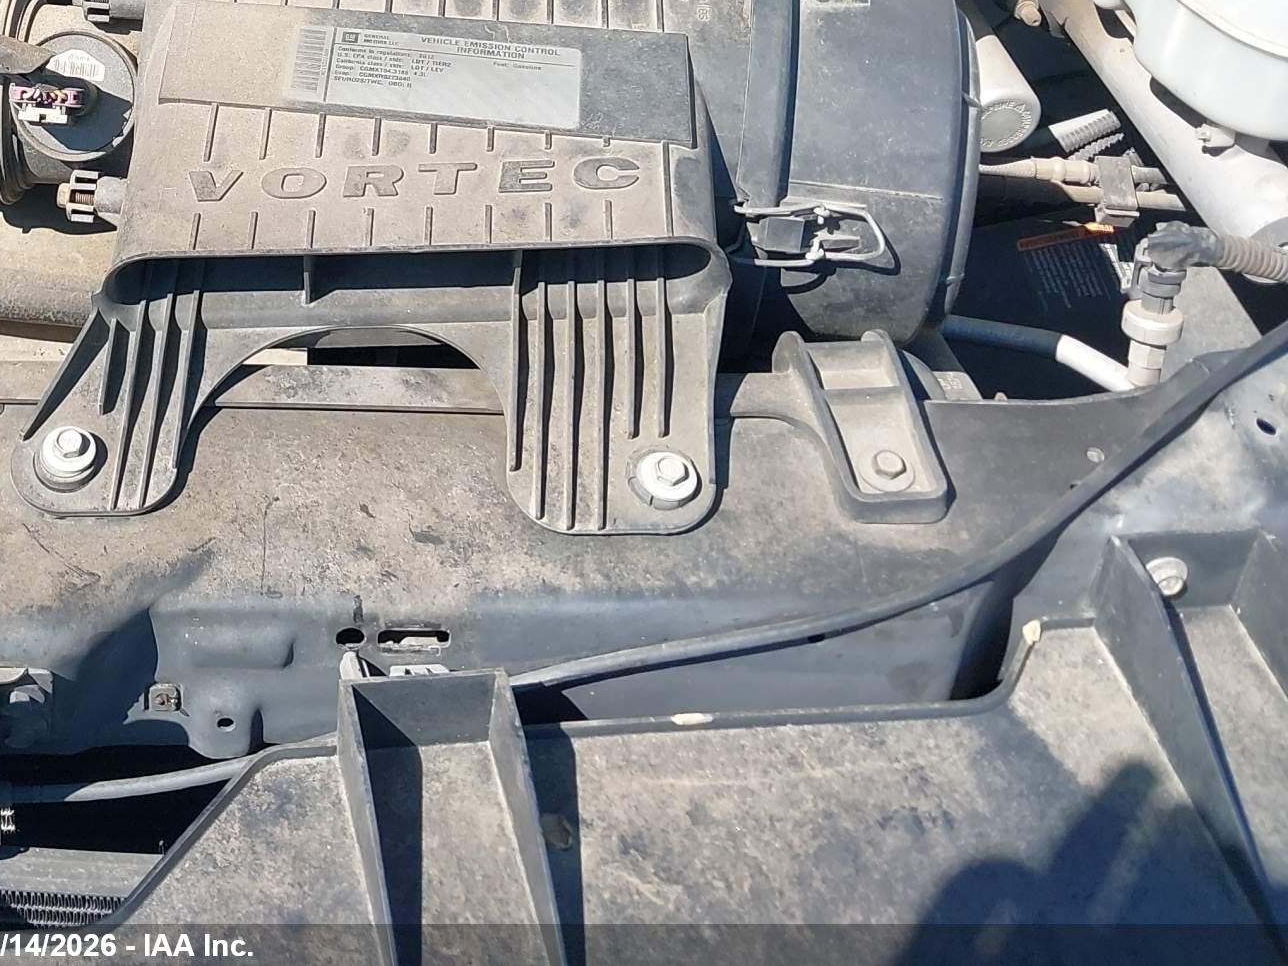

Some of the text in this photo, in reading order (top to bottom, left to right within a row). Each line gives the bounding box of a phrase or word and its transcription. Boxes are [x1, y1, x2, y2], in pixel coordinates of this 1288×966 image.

[421, 36, 560, 56] VEHICLE EMISSION CONTROL
[457, 47, 525, 59] INFORMATION
[188, 156, 641, 202] VORTEC
